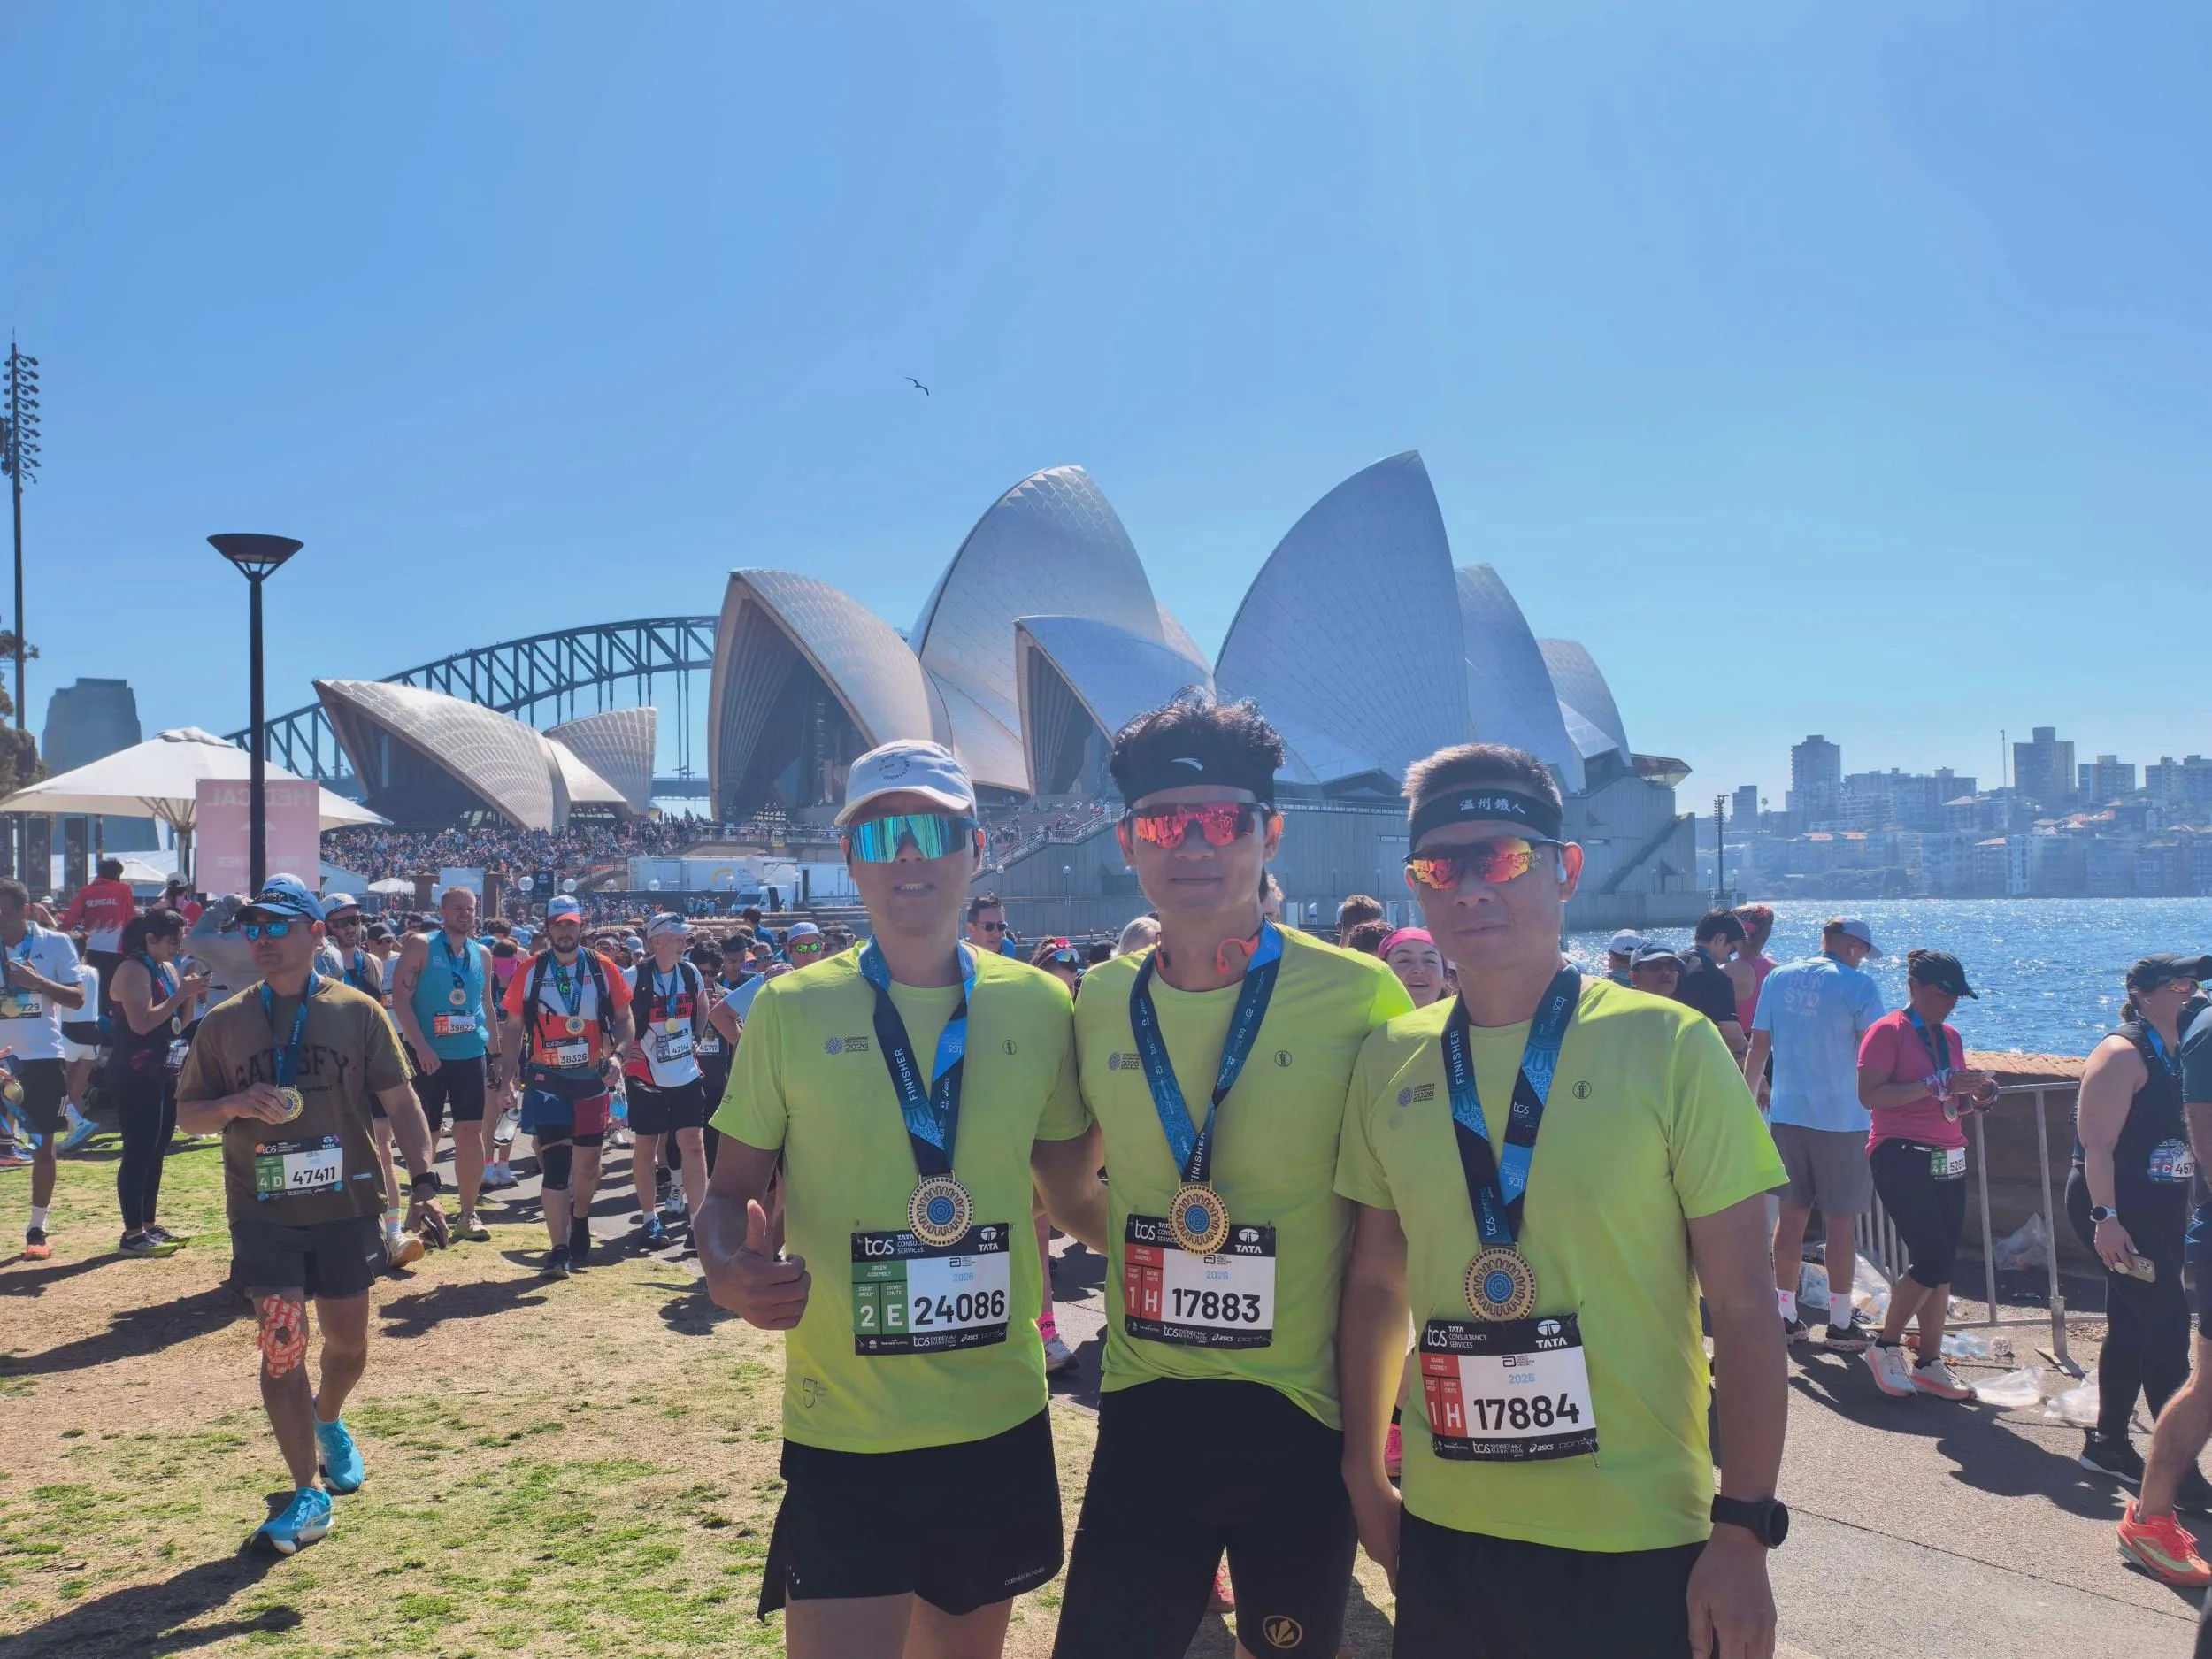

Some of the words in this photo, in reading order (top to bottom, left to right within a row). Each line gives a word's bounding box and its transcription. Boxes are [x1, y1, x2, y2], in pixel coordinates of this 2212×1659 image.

[1785, 987, 1820, 1007] SYD
[236, 1045, 349, 1090] SATSFY
[560, 1054, 588, 1064] 38326
[1451, 1030, 1465, 1085] FINISHER
[894, 1048, 918, 1102] FINISHER
[1513, 1101, 1529, 1114] tcs
[1191, 1132, 1205, 1182] INISHER
[259, 1176, 268, 1187] 4
[273, 1176, 282, 1187] D
[292, 1166, 335, 1185] 47411
[1135, 1219, 1155, 1240] tcs
[1486, 1217, 1497, 1236] tcs
[864, 1237, 895, 1256] tcs
[979, 1242, 999, 1252] TATA
[1234, 1244, 1262, 1254] TATA
[914, 1289, 1005, 1326] 24086
[1129, 1286, 1135, 1310] 1
[1145, 1289, 1157, 1313] H
[1172, 1287, 1261, 1324] 17883
[860, 1305, 875, 1327] 2
[887, 1304, 902, 1327] E
[913, 1335, 930, 1347] tcs
[1164, 1325, 1179, 1338] tcs
[1427, 1325, 1447, 1347] tcs
[1448, 1333, 1487, 1341] CONSULTANCY
[1535, 1337, 1568, 1348] TATA
[1430, 1402, 1438, 1425] 1
[1445, 1403, 1462, 1428] H
[1473, 1393, 1580, 1431] 17884
[1472, 1441, 1491, 1454] tcs
[1537, 1443, 1554, 1452] asics
